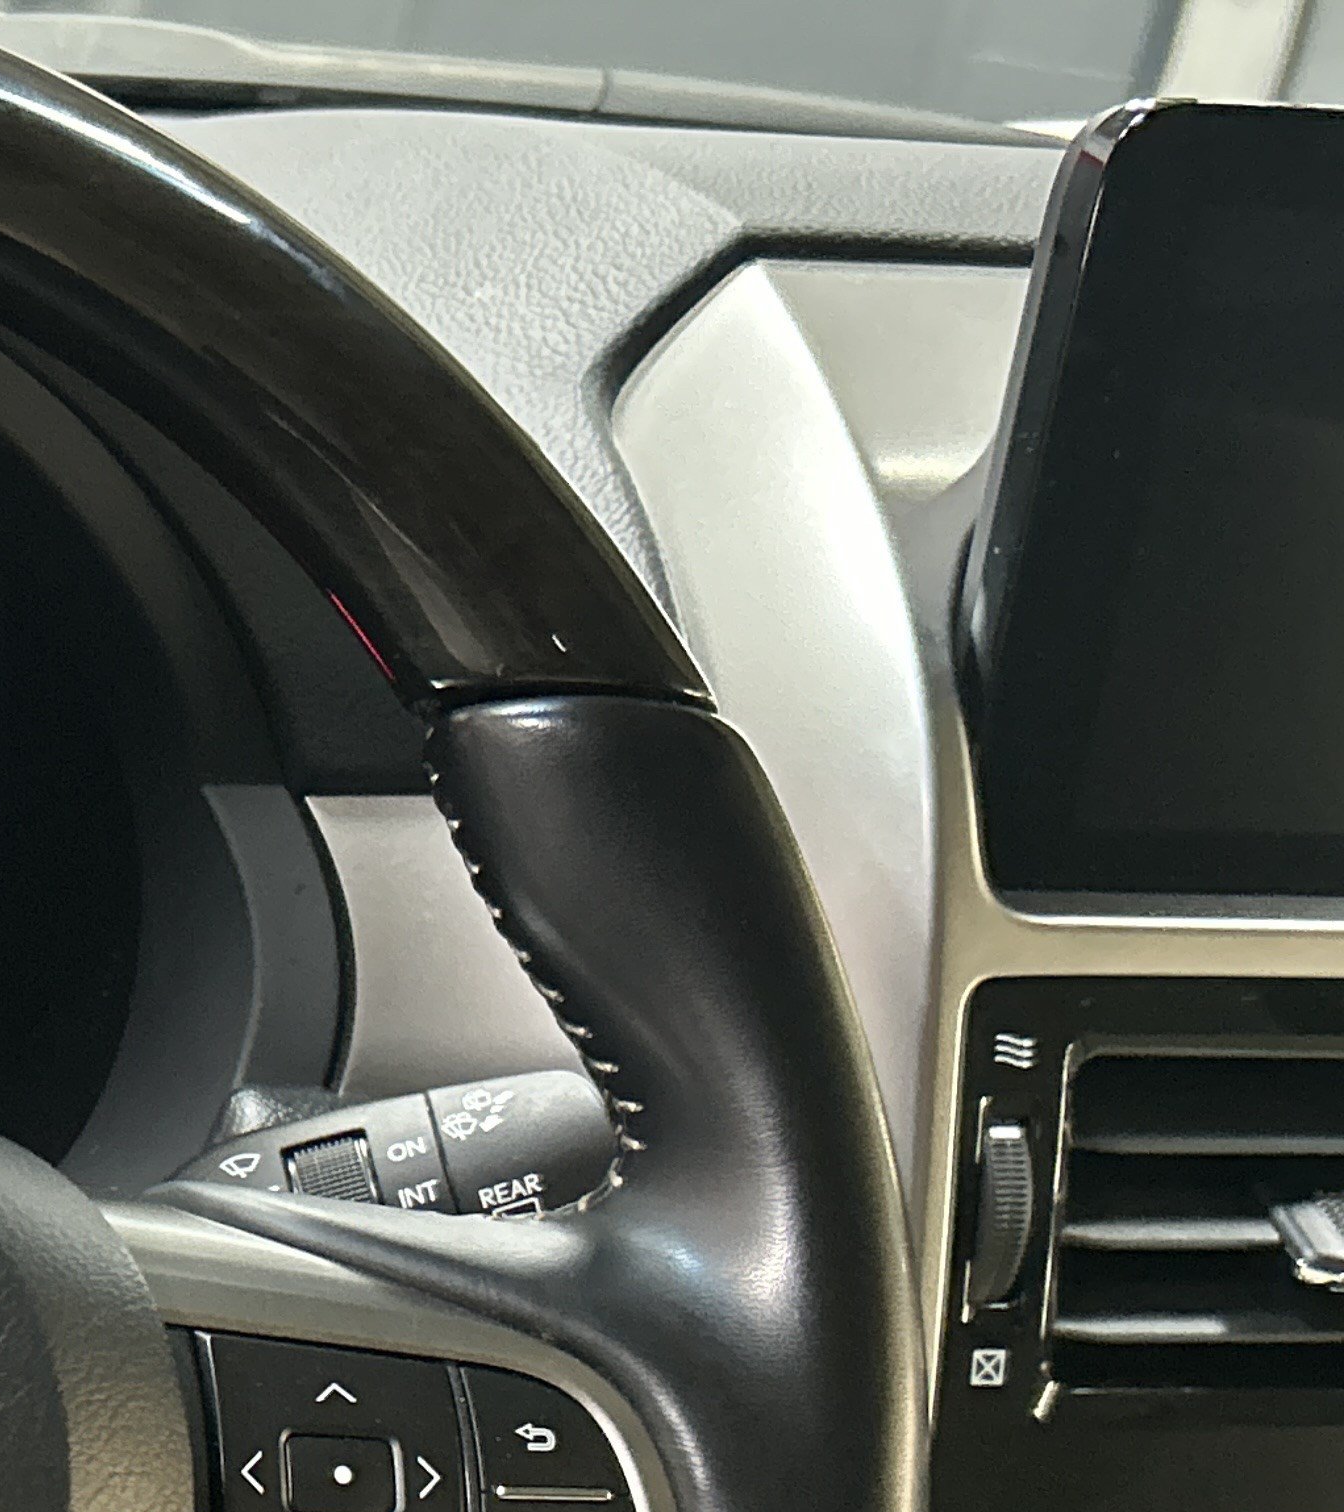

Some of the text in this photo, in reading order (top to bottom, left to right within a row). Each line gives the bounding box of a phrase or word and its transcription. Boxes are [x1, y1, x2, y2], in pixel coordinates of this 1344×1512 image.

[386, 1136, 427, 1162] ON
[397, 1178, 439, 1209] INT
[477, 1173, 544, 1209] REAR
